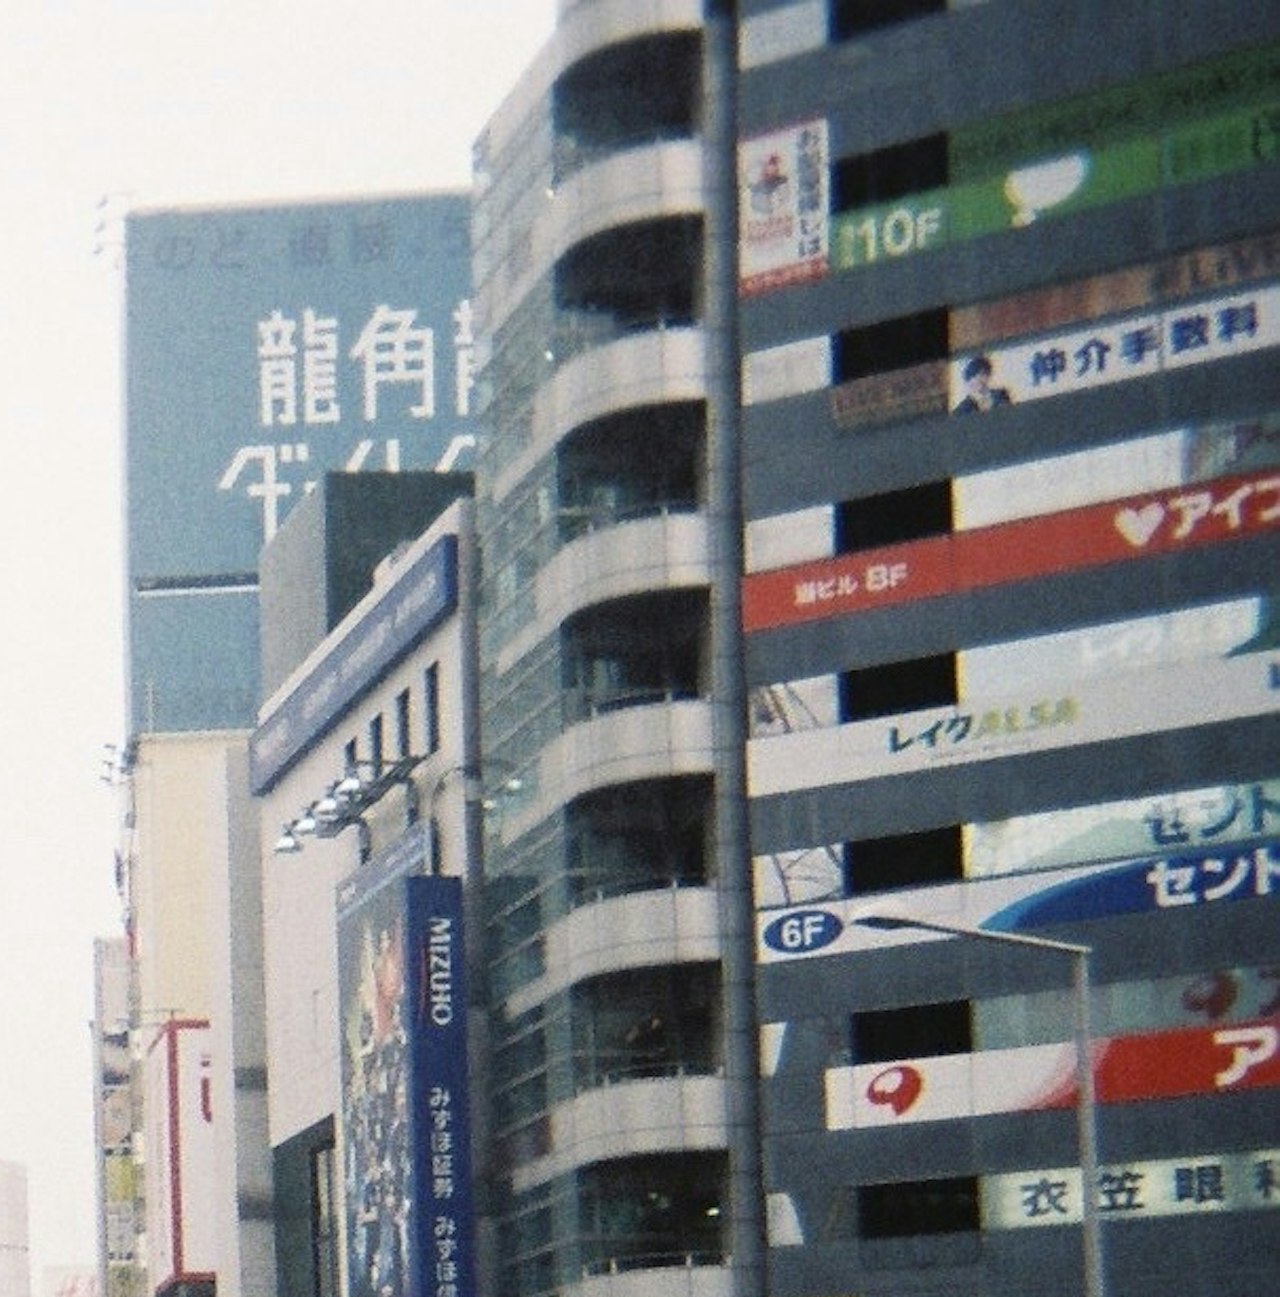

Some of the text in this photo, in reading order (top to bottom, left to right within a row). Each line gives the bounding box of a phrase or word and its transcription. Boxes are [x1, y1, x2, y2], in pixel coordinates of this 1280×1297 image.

[1030, 302, 1259, 386] 仲介手数料
[888, 712, 973, 753] レイク
[781, 914, 824, 950] 6F
[430, 918, 453, 1026] MIZUHO
